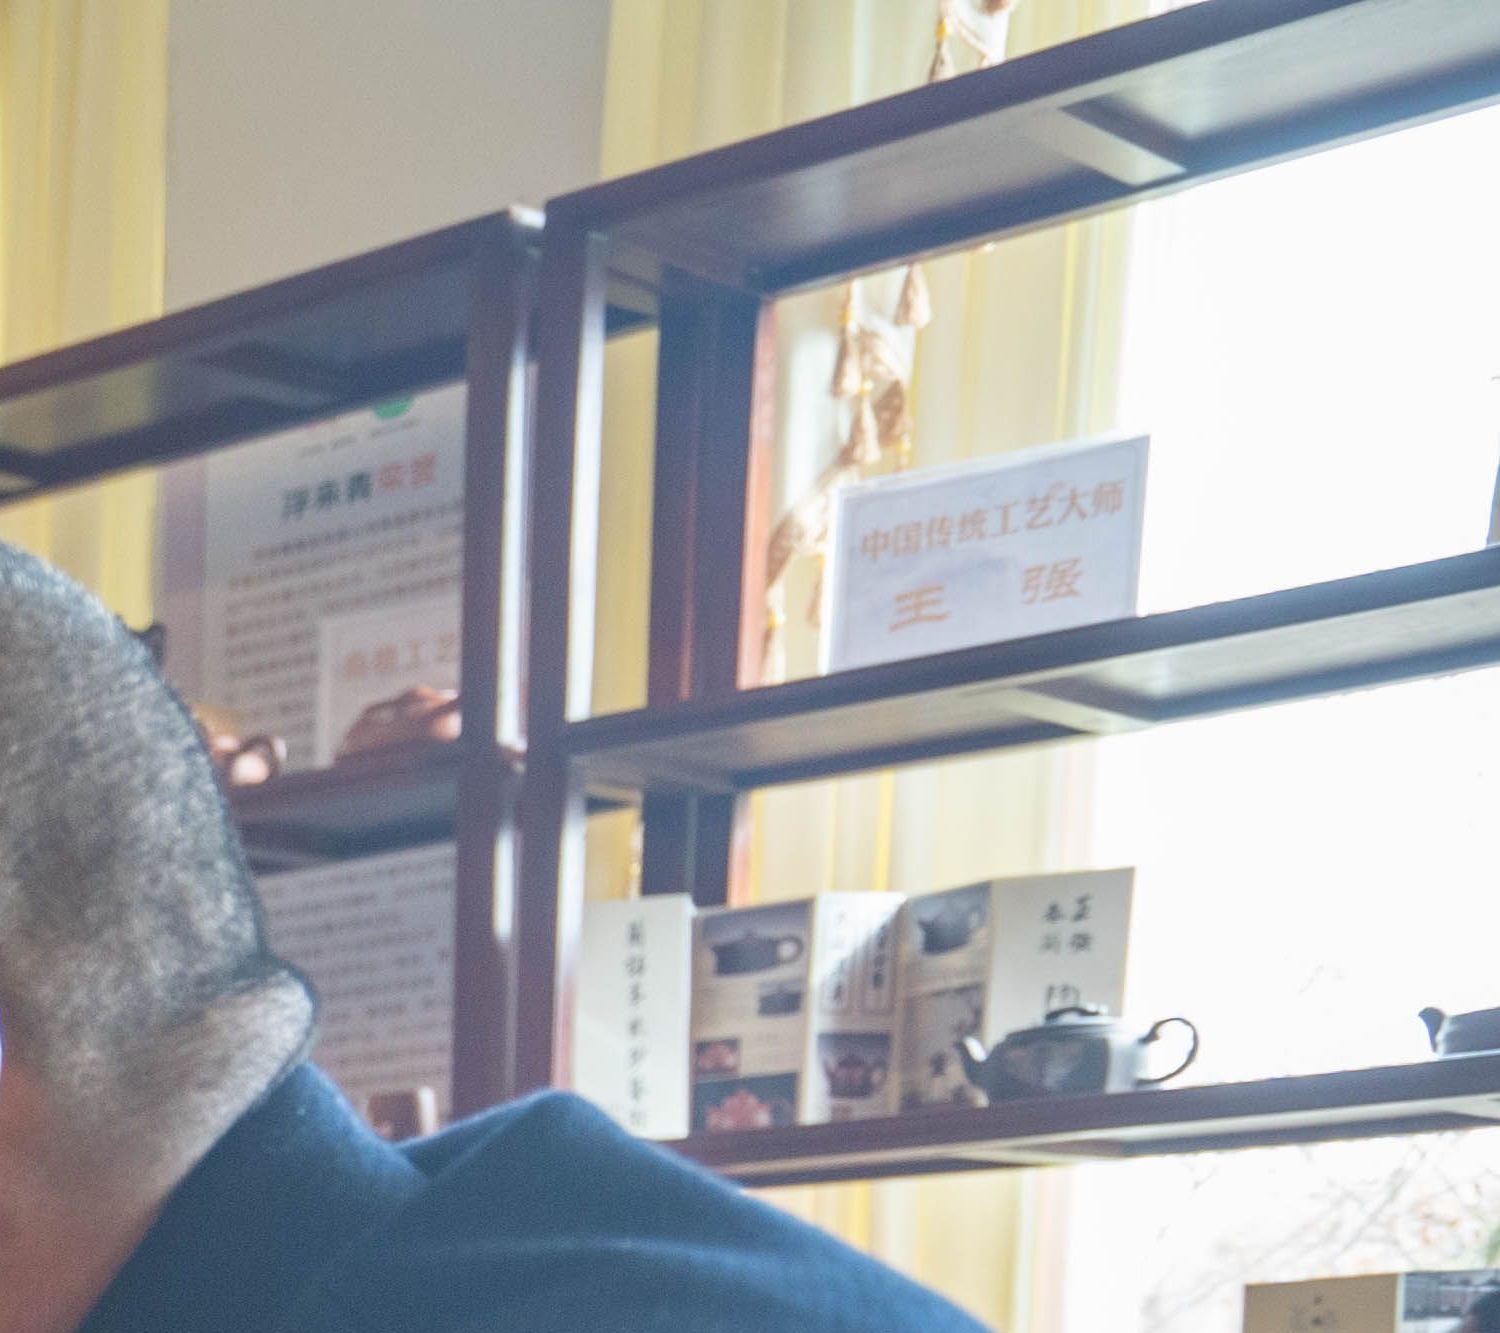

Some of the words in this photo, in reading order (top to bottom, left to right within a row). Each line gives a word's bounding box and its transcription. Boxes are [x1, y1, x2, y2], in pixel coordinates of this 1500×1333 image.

[860, 480, 1127, 561] 中国传统工艺大师
[889, 557, 1083, 633] 王强
